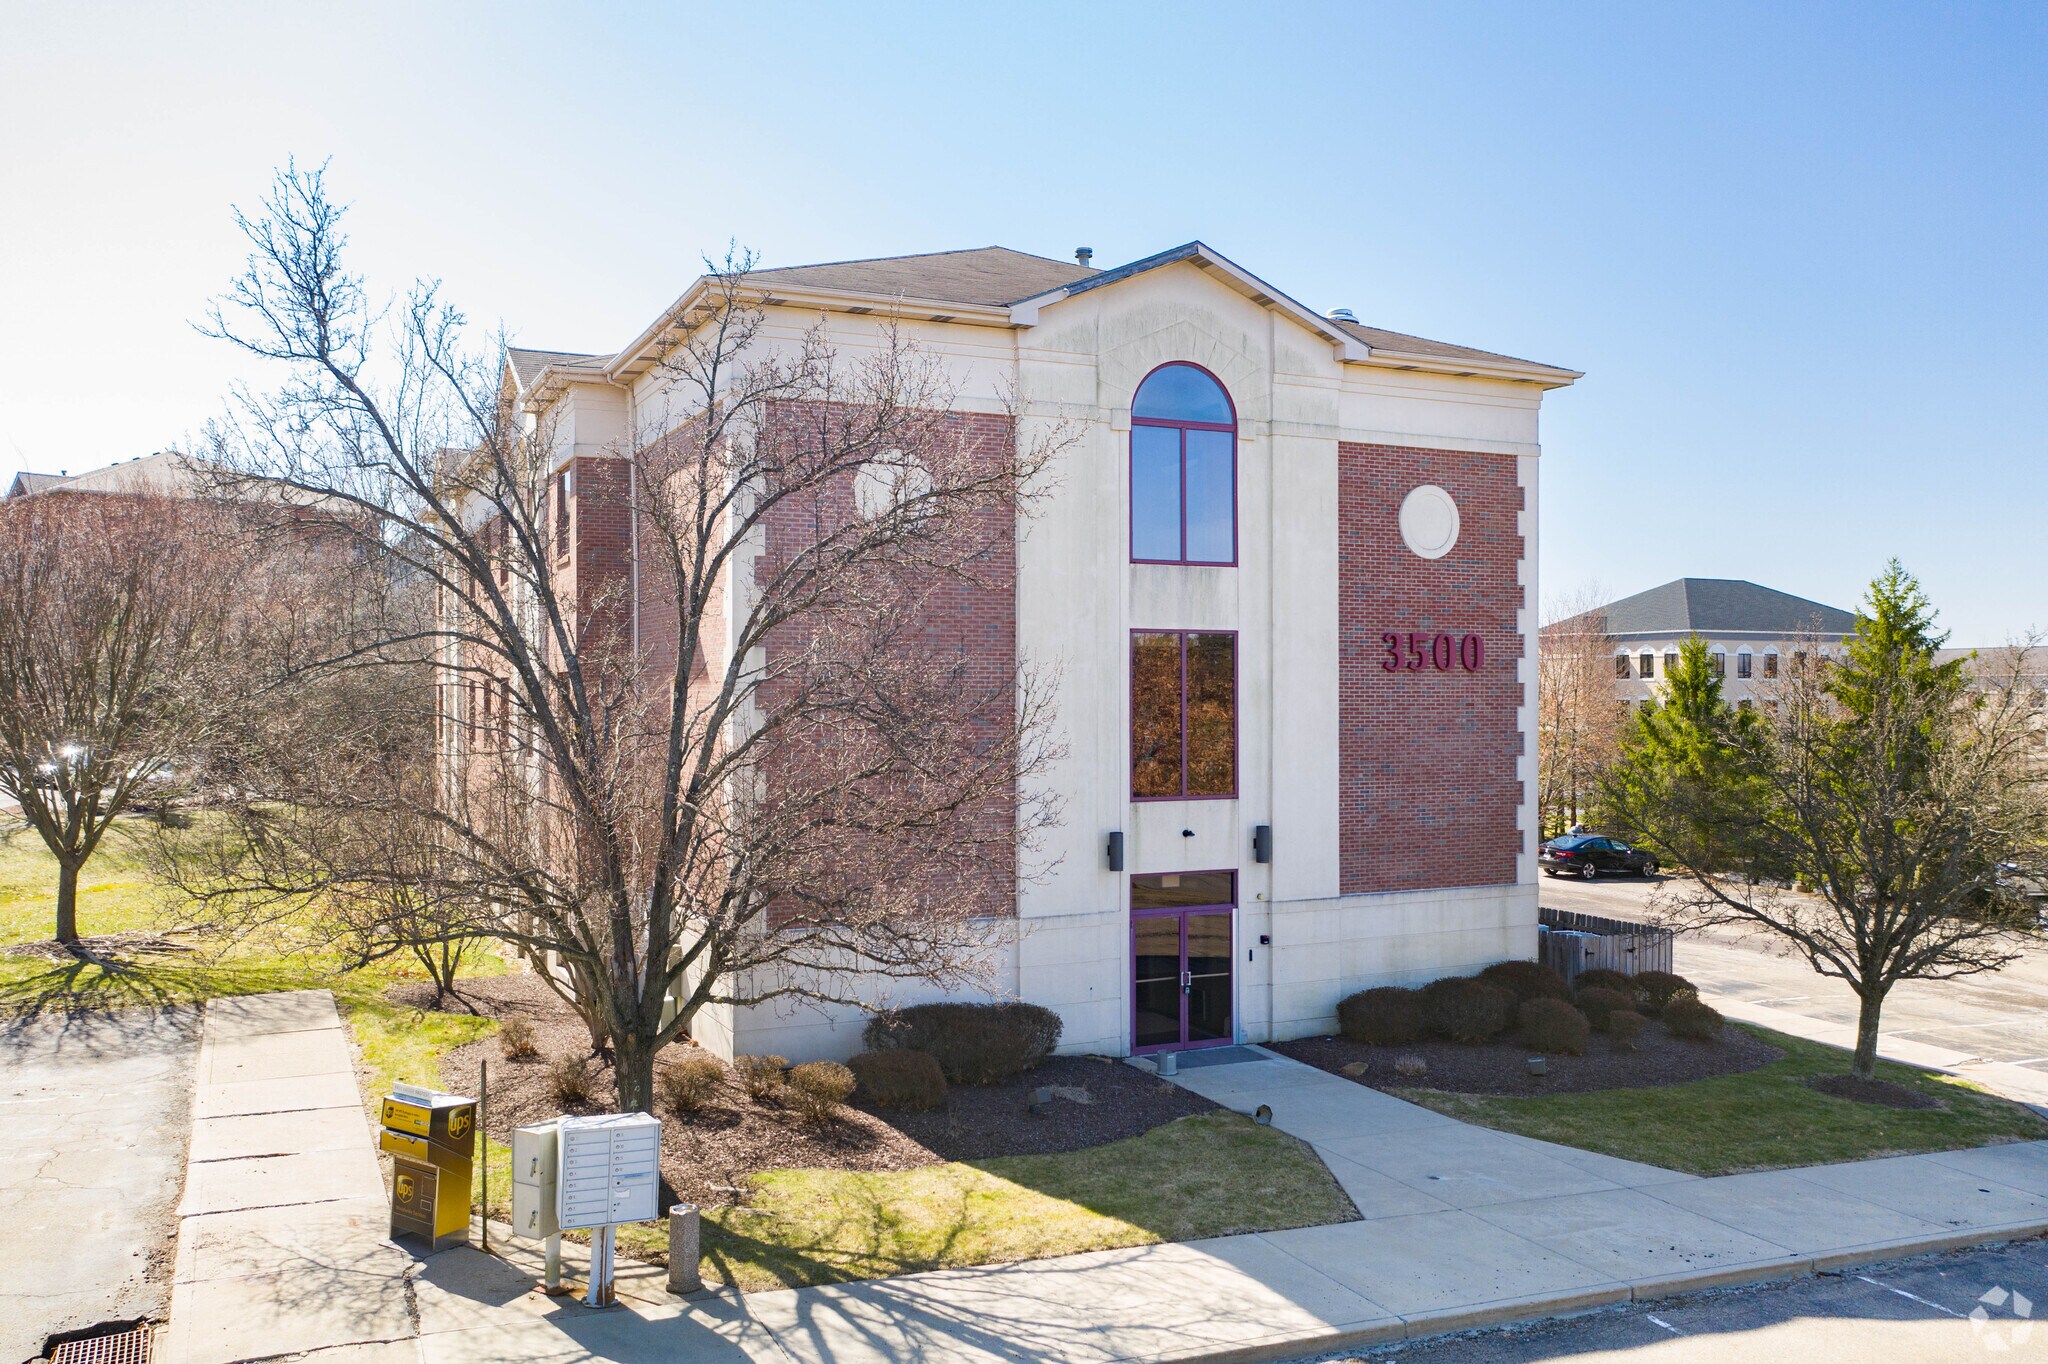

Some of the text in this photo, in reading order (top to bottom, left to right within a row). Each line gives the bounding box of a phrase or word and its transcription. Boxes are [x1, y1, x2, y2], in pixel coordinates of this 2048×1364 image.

[1382, 632, 1485, 672] 3500
[450, 1114, 470, 1135] ups
[398, 1182, 413, 1199] ups
